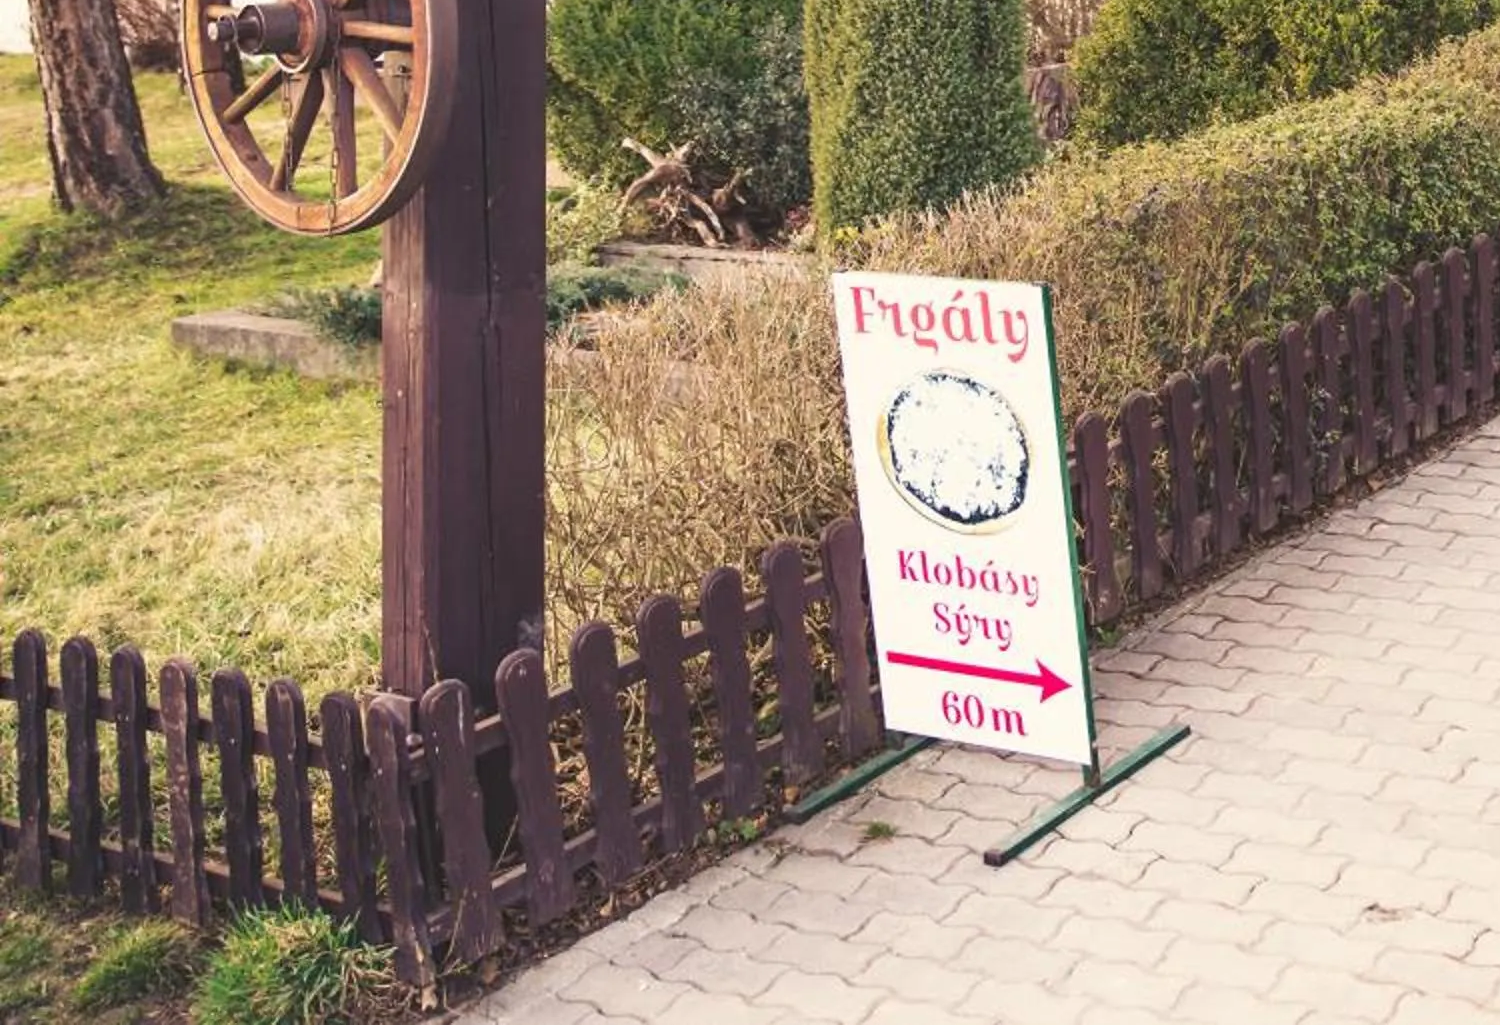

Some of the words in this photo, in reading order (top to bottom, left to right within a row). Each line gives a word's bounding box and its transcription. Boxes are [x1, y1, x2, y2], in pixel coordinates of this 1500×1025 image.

[849, 286, 1029, 363] Frgály
[897, 549, 1039, 607] Klobásy
[933, 603, 1013, 652] Sýry
